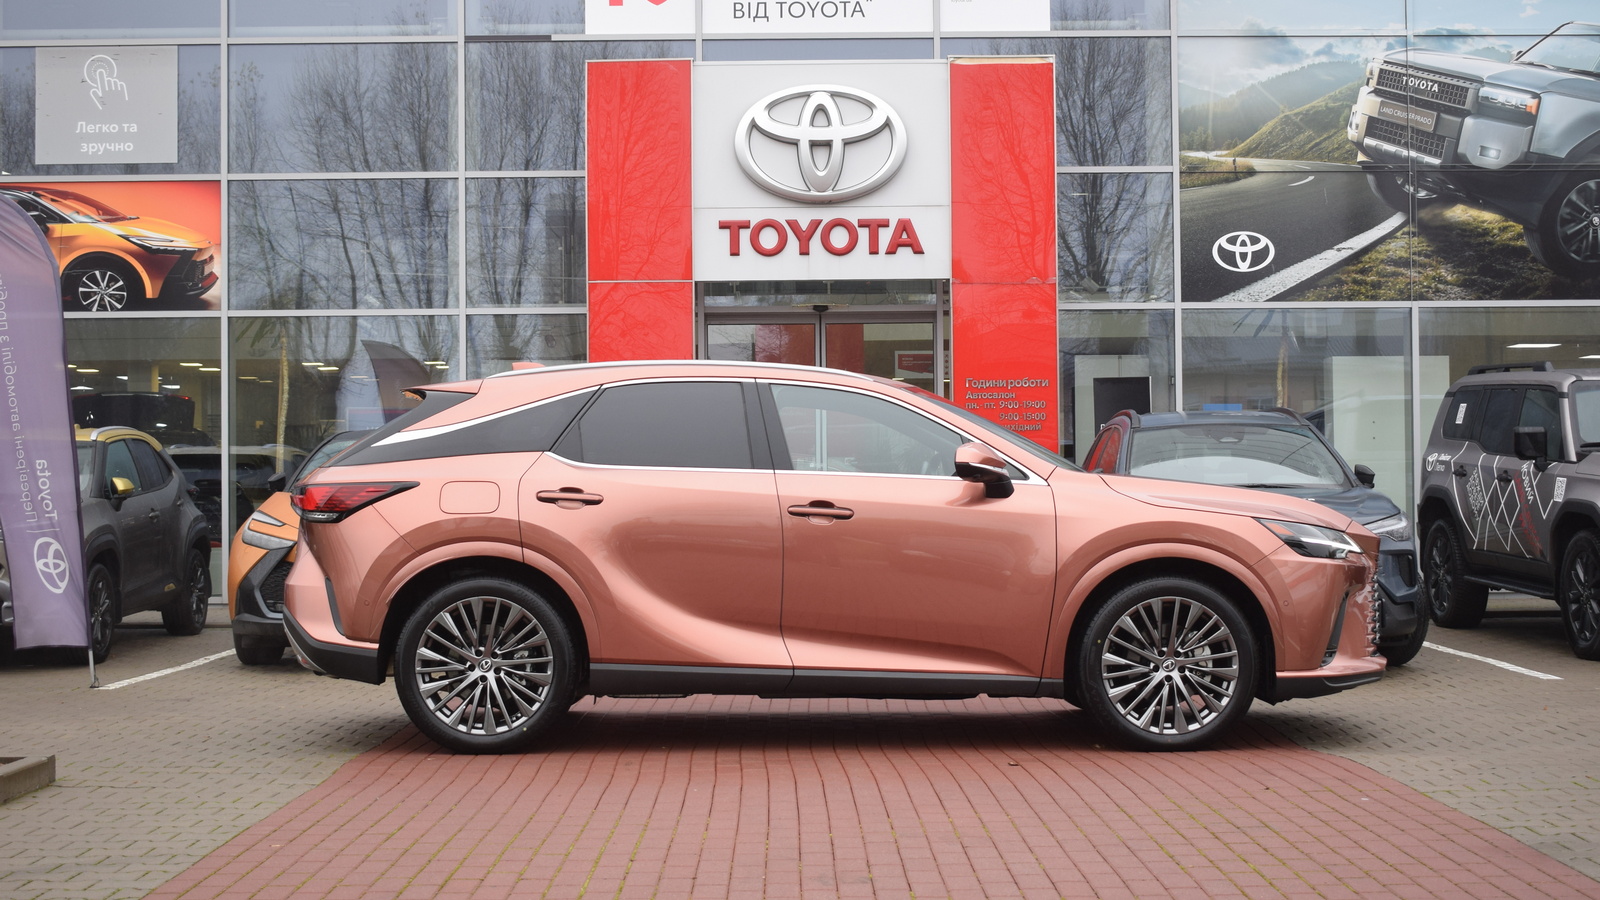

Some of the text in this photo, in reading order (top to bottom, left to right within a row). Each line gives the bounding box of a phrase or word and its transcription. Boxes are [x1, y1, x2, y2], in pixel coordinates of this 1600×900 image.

[733, 2, 769, 22] ВІД
[1402, 76, 1439, 92] TOYOTA
[1380, 106, 1393, 115] LAND
[75, 121, 138, 133] Легко та
[80, 142, 134, 155] зручно
[718, 217, 925, 257] TOYOTA
[965, 377, 1049, 389] Години роботи
[965, 391, 1016, 399] Автосалон
[1520, 461, 1534, 505] НОВИЙ
